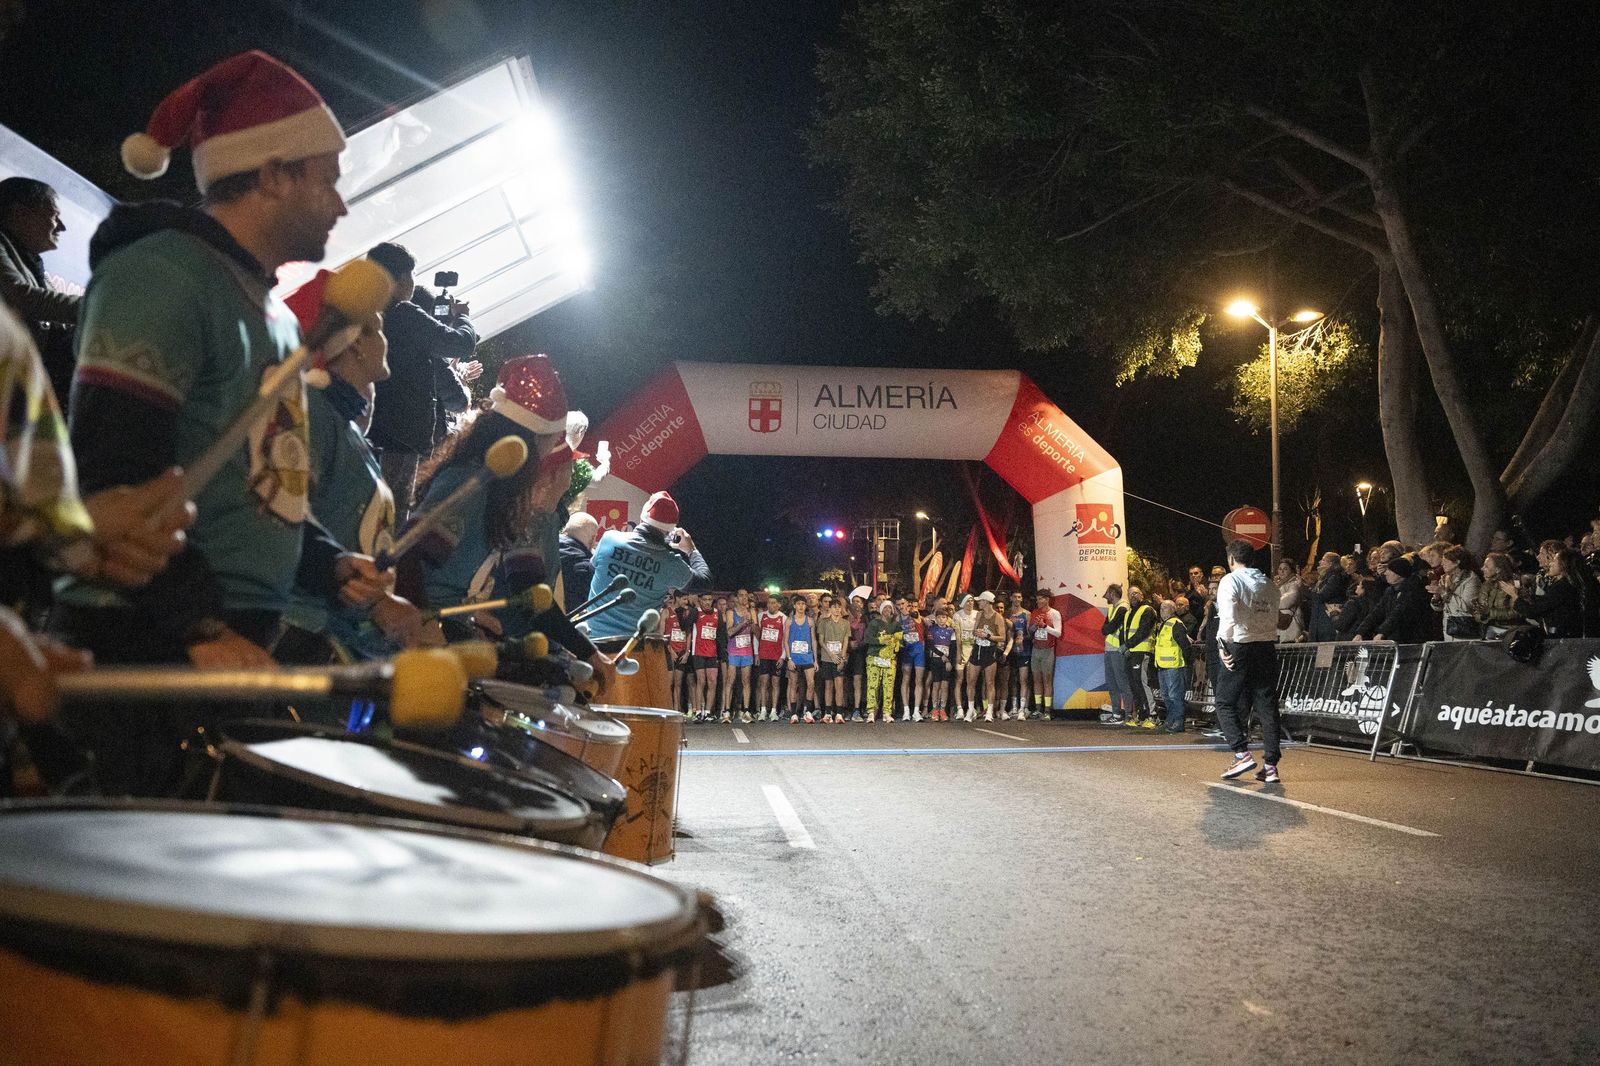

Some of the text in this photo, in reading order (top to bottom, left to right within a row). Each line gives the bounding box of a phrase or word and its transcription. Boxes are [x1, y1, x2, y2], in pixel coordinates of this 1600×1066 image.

[814, 381, 958, 410] ALMERÍA
[615, 404, 675, 459] ALMERÍA
[813, 413, 887, 430] CIUDAD
[626, 415, 685, 470] es deporte
[1018, 422, 1076, 474] es deporte
[610, 546, 661, 574] BLOCO
[1079, 548, 1117, 556] DEPORTES
